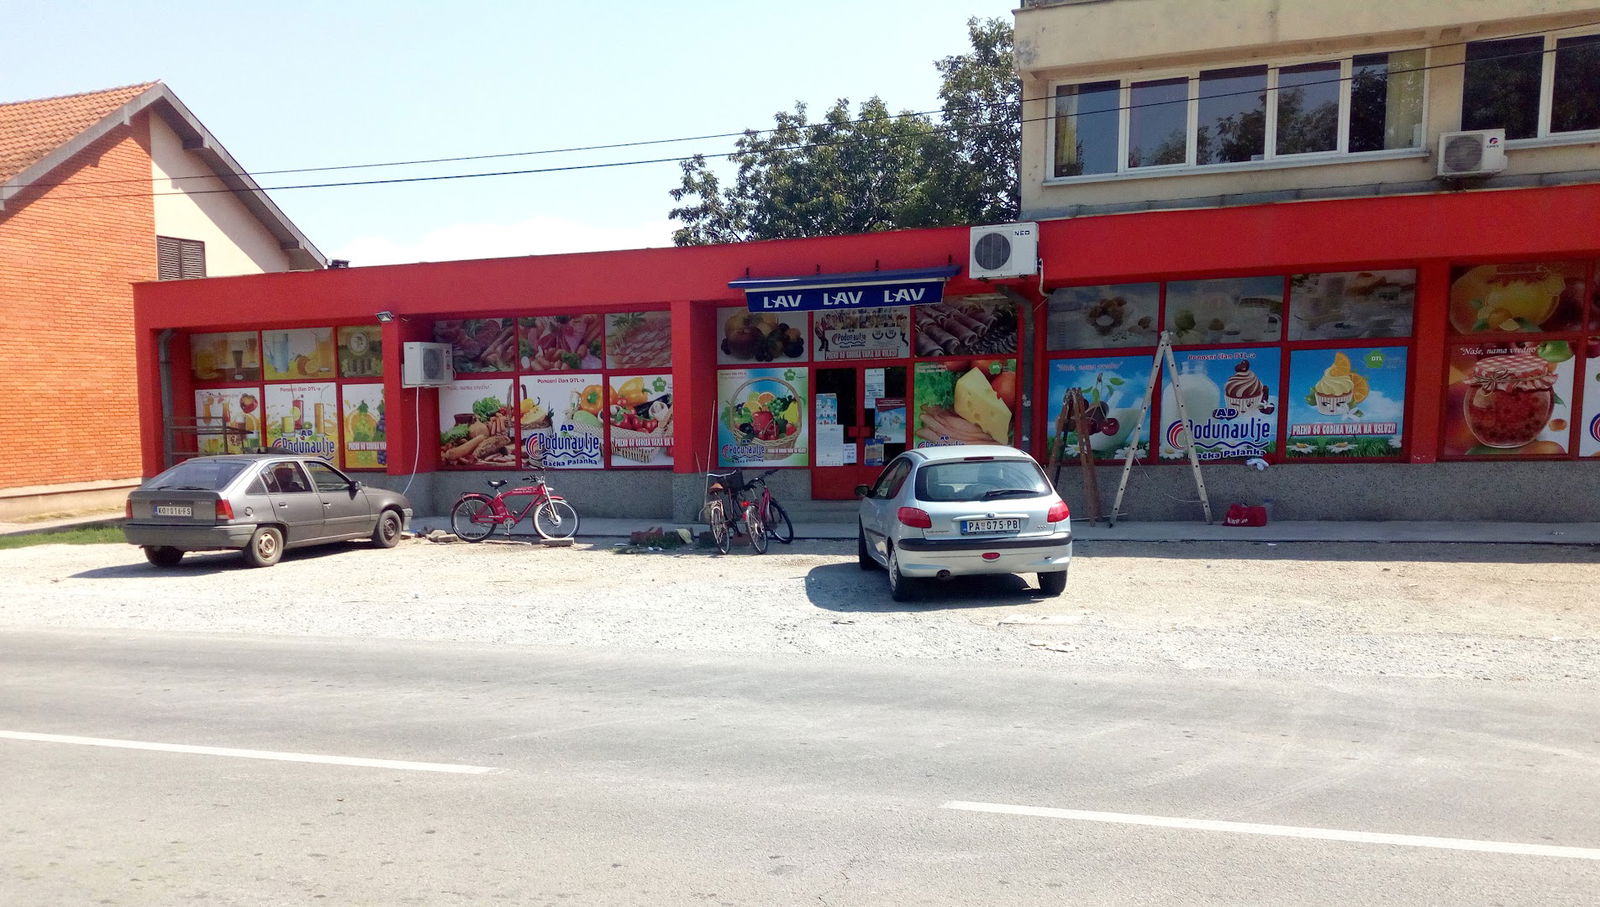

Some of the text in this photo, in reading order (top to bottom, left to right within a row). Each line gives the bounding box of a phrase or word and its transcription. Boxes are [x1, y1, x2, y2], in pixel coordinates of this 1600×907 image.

[763, 294, 802, 309] LAV
[823, 290, 863, 306] LAV
[883, 287, 926, 303] LAV
[1216, 408, 1236, 417] AD
[560, 424, 574, 432] AD
[539, 432, 599, 453] Podunavlje
[969, 522, 980, 530] PA
[986, 520, 1018, 530] 075-PB
